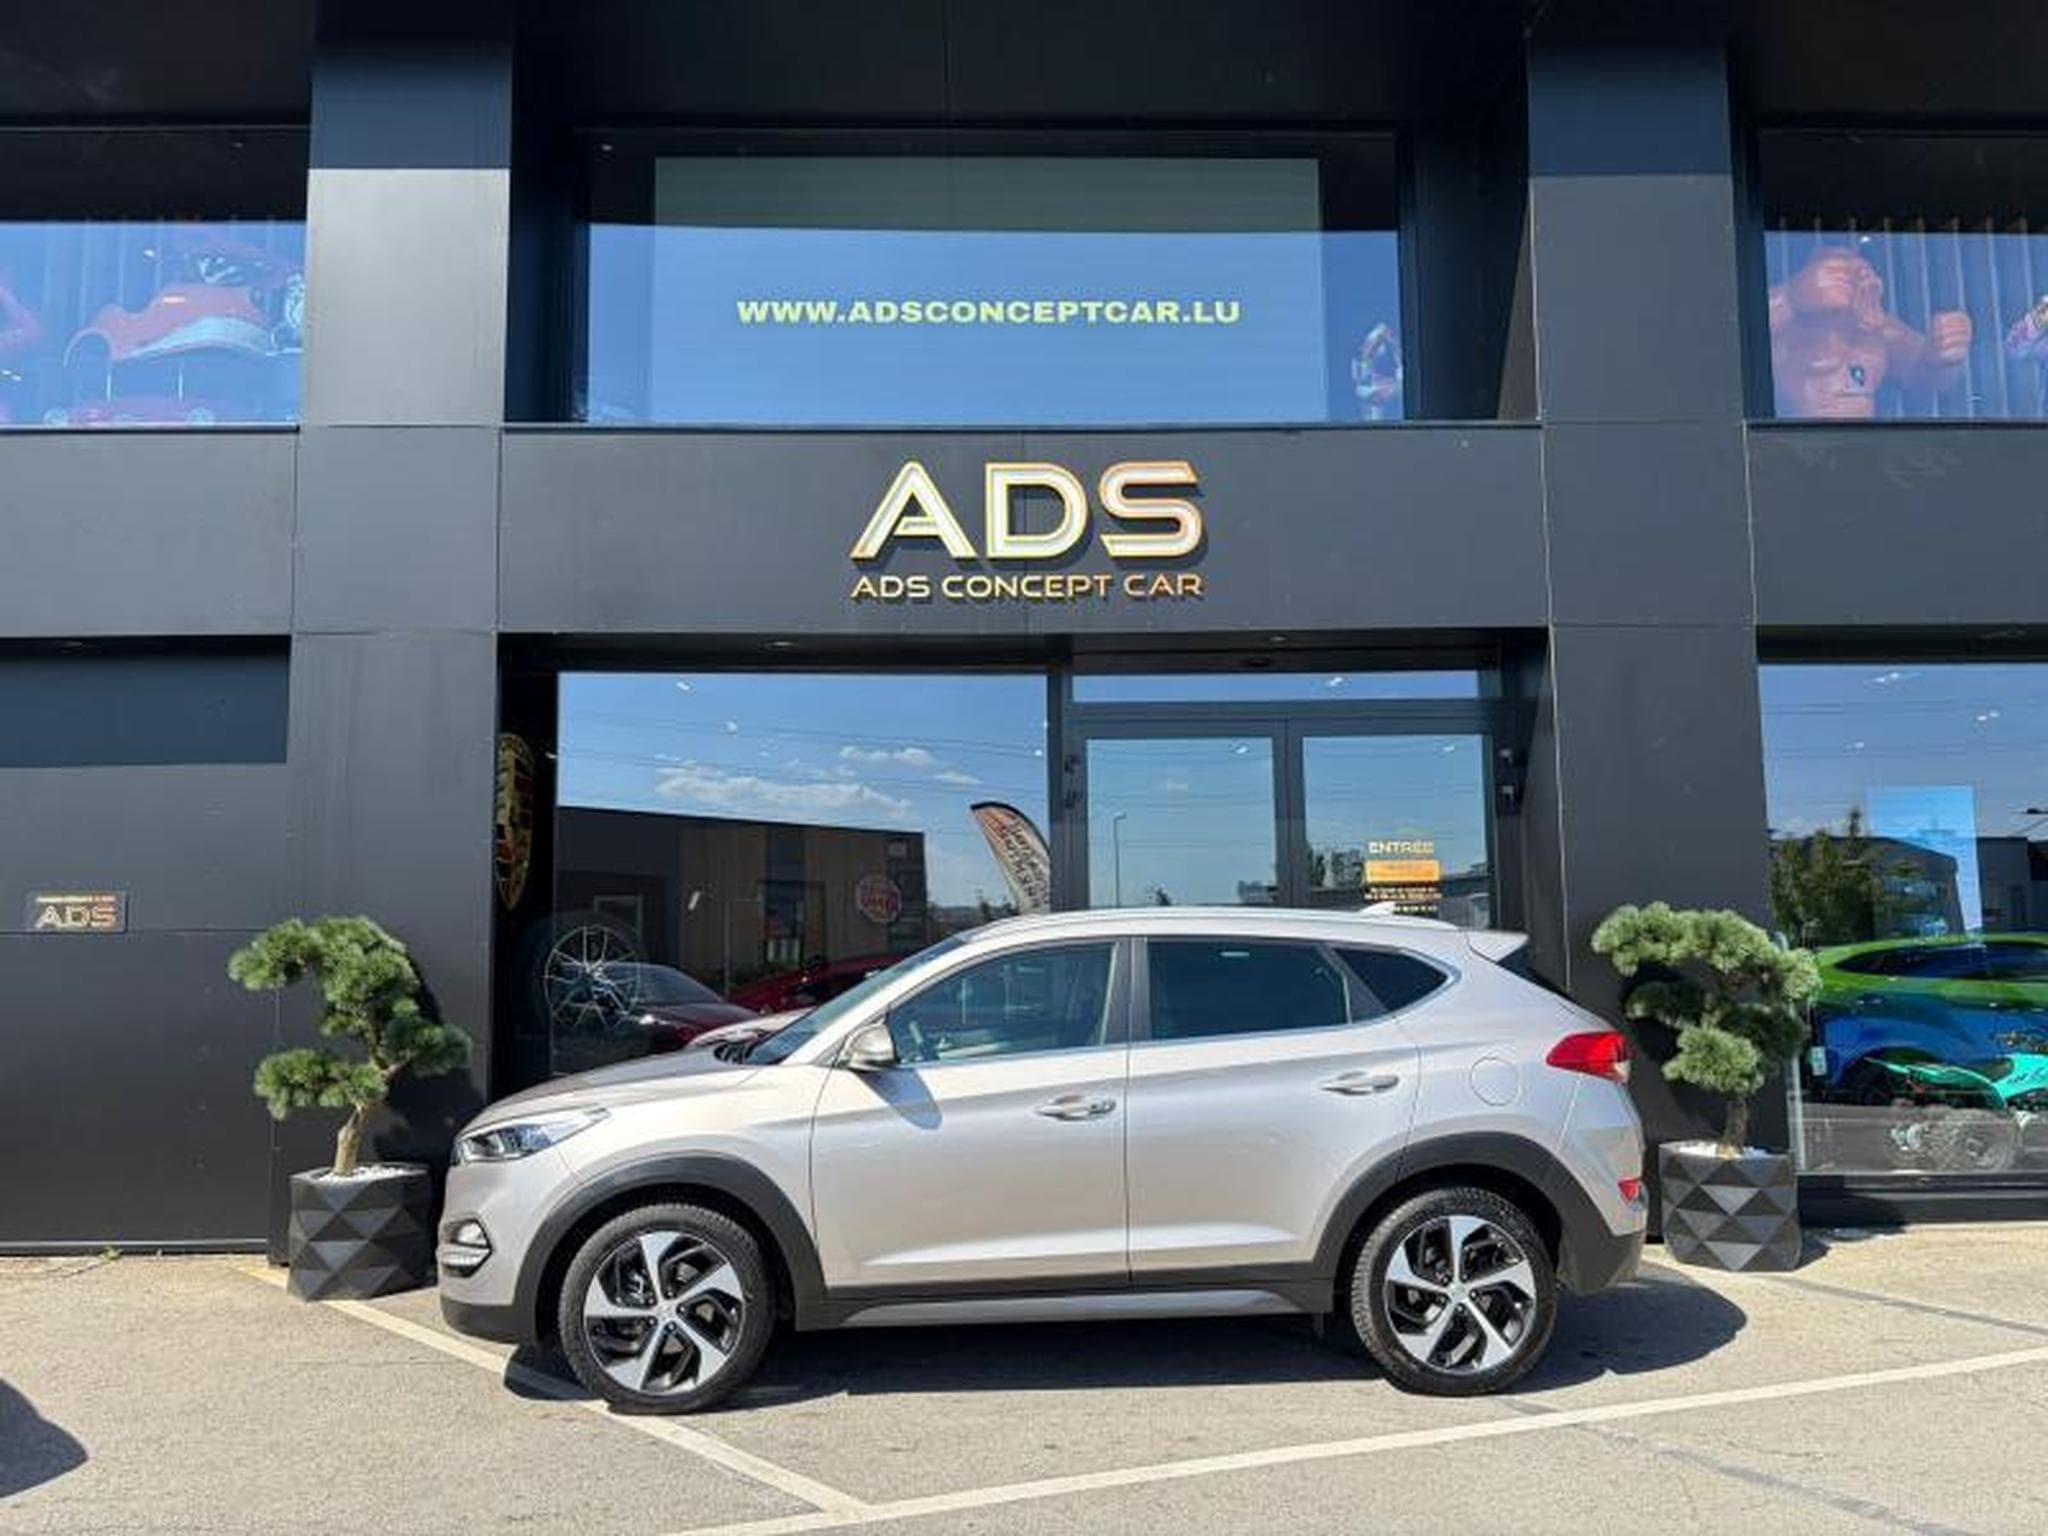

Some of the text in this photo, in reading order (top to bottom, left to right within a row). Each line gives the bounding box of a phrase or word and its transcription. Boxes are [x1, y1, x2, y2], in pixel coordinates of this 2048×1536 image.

[736, 300, 1241, 323] WWW.ADSCONCEPTCAR.LU
[849, 459, 1204, 559] ADS
[851, 573, 1202, 599] ADS CONCEPT CAR
[35, 904, 116, 929] ADS
